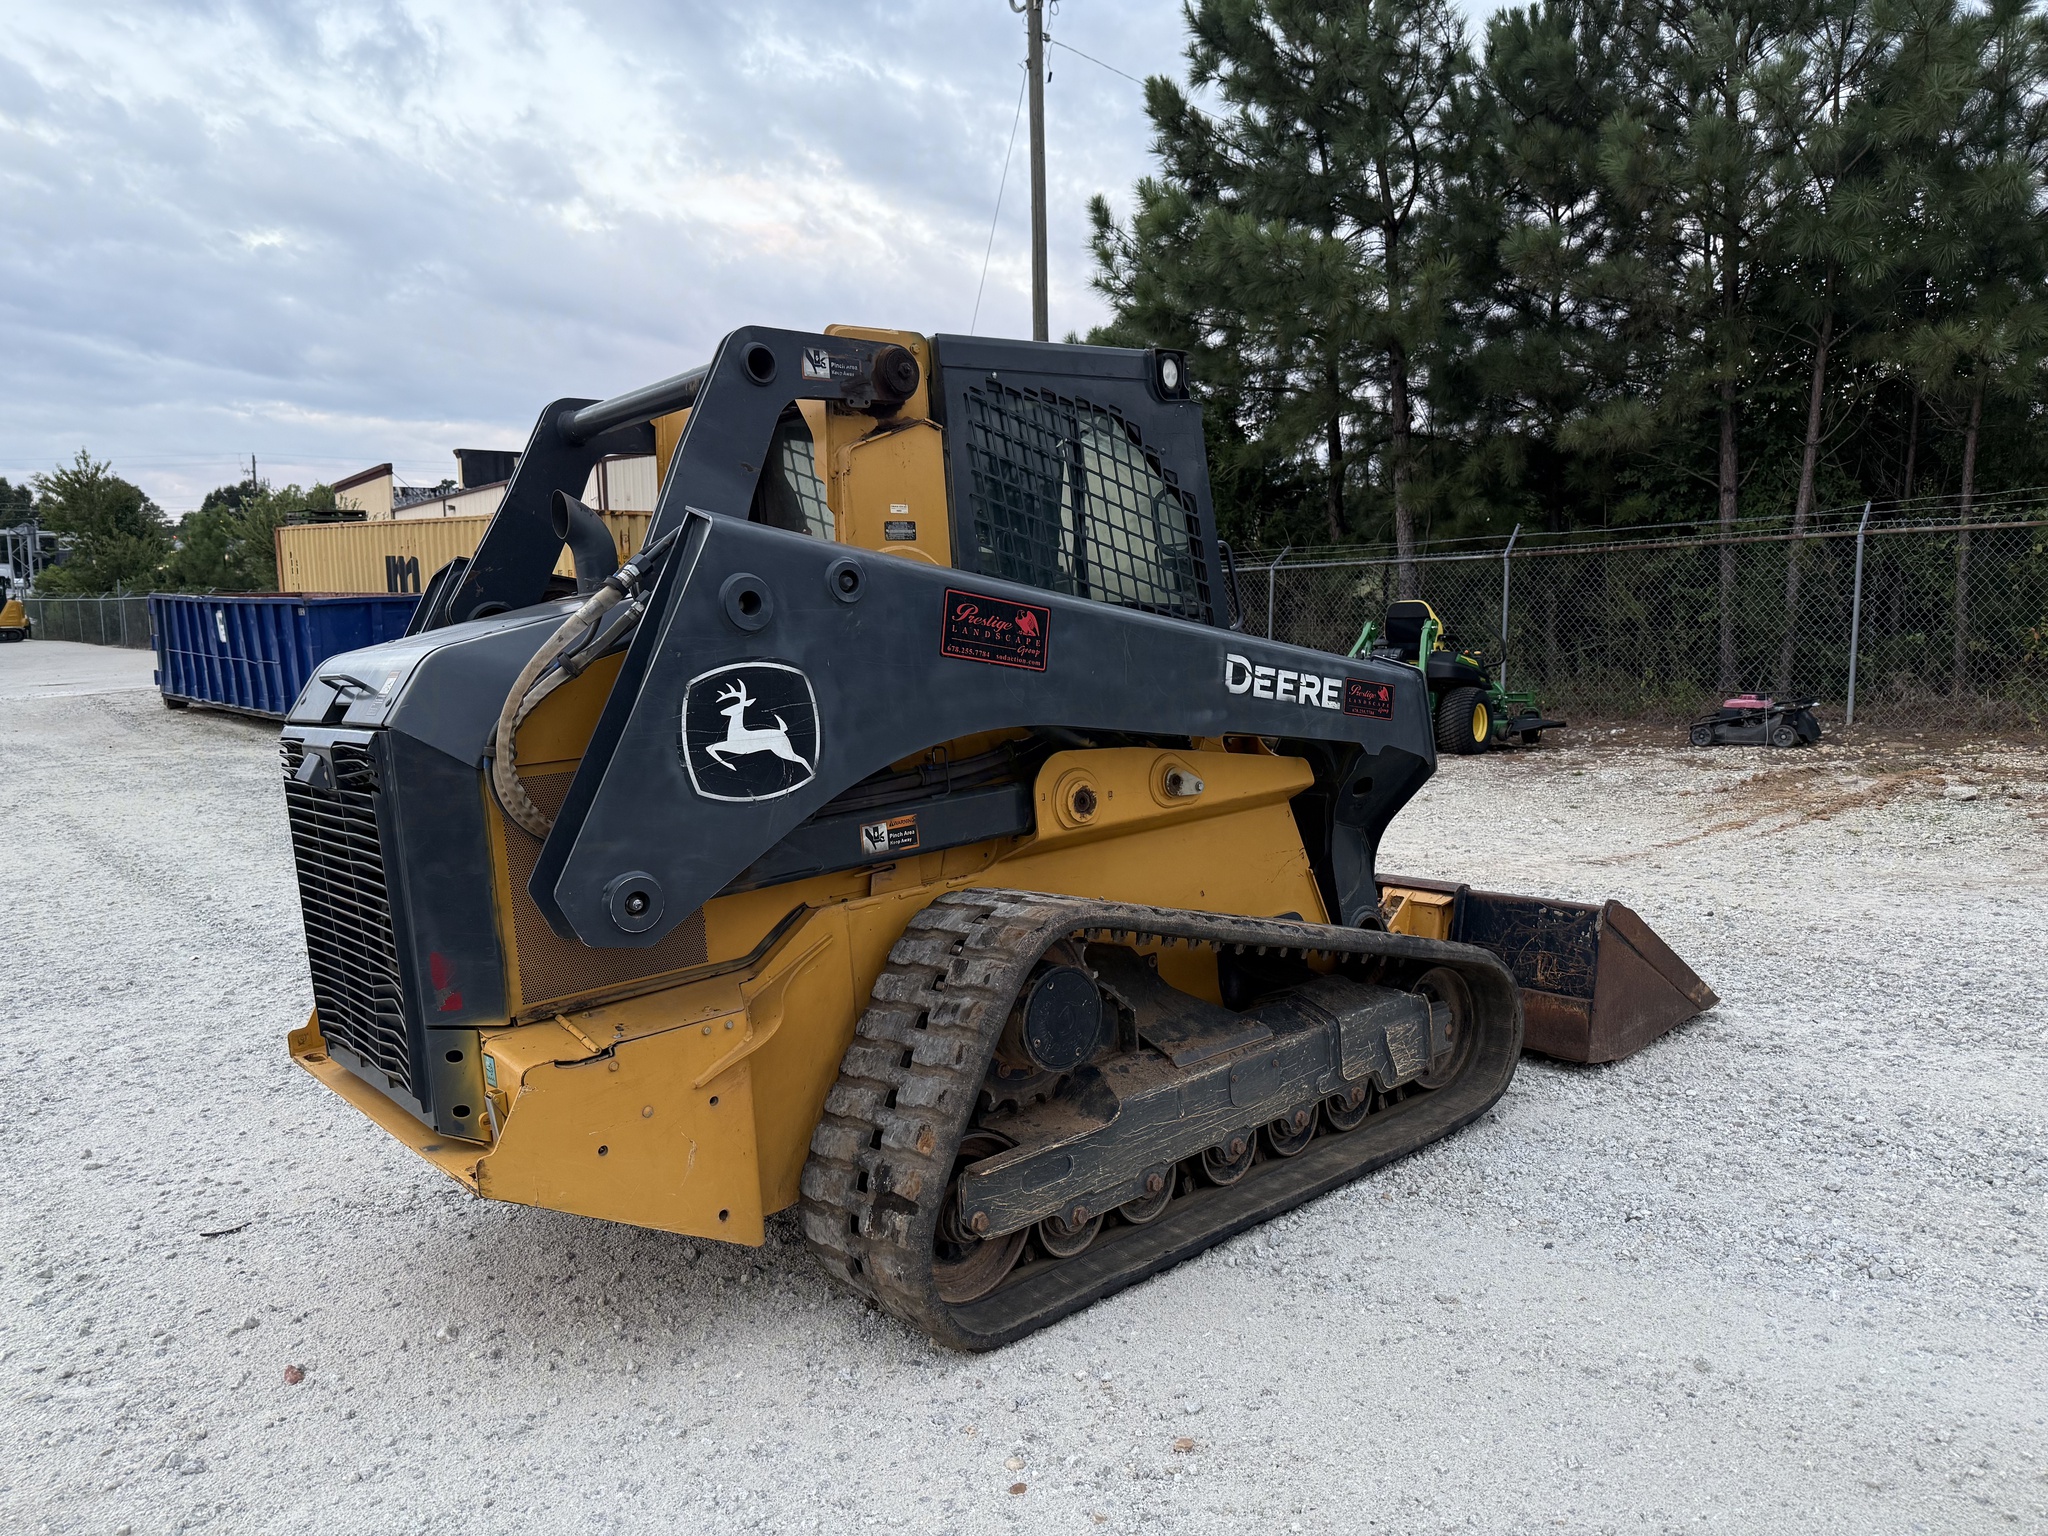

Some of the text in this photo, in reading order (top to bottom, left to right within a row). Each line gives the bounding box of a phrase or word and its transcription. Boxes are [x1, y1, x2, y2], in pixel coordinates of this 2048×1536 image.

[951, 603, 1013, 632] Prestige
[951, 624, 1041, 647] LANDSCAPE
[947, 643, 1041, 666] 678.255.7784 sodaction.com
[1017, 645, 1040, 658] Group
[1225, 653, 1342, 710] DEERE
[1348, 684, 1377, 700] Prestige
